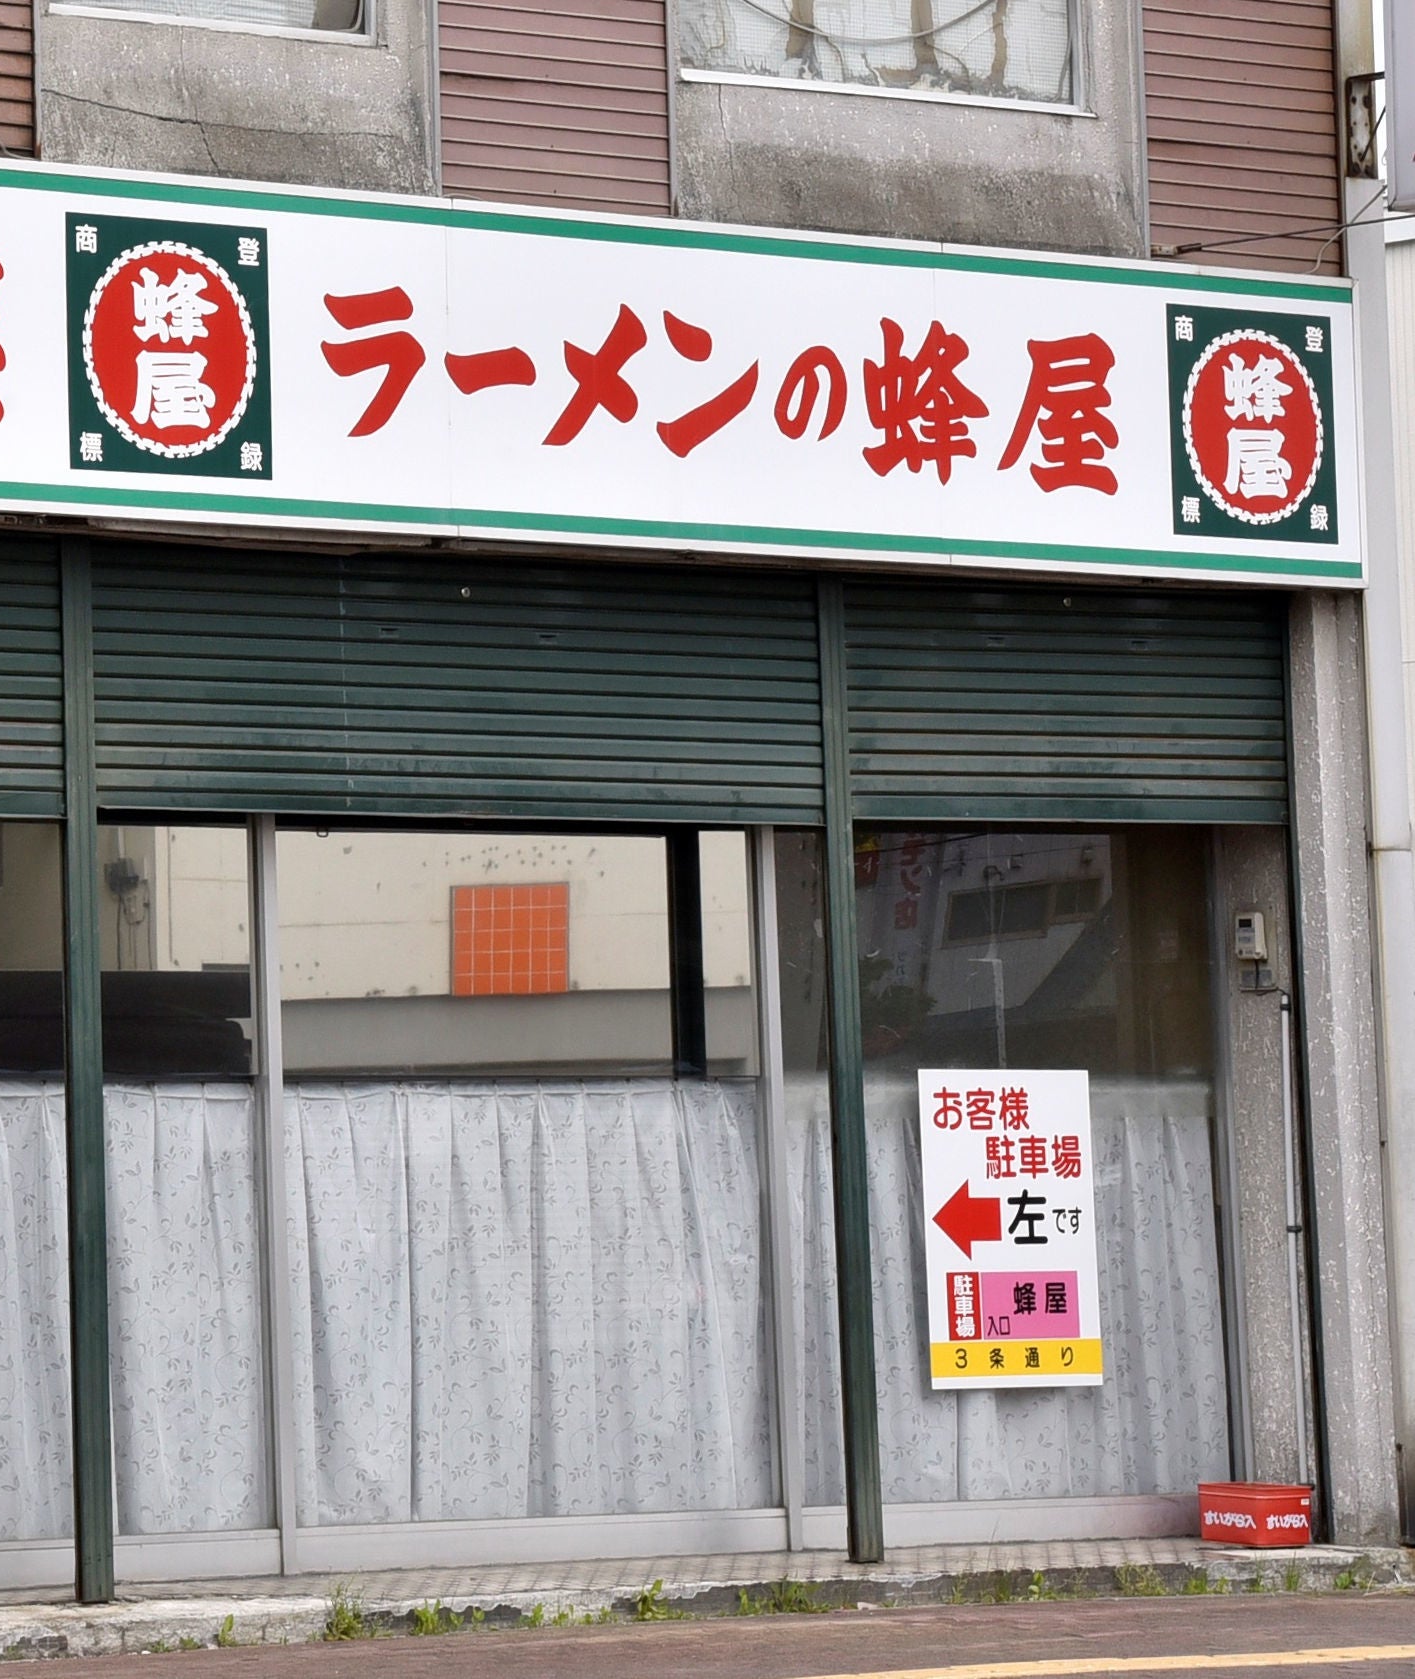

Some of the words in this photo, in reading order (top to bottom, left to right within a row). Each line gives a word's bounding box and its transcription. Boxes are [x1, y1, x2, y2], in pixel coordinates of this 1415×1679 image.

[74, 223, 99, 255] 商
[237, 236, 261, 268] 登
[1173, 314, 1195, 342] 商
[1304, 325, 1325, 354] 登
[130, 266, 219, 430] 蜂屋
[321, 286, 1119, 495] ラーメンの蜂屋
[1222, 352, 1293, 500] 蜂屋
[78, 431, 104, 463] 標
[240, 441, 263, 473] 録
[1180, 495, 1202, 525] 標
[1309, 503, 1329, 532] 録
[933, 1087, 1030, 1131] お客様
[986, 1135, 1081, 1180] 駐車場
[952, 1274, 976, 1338] 駐車場
[1013, 1281, 1068, 1315] 蜂屋
[987, 1316, 1011, 1336] 入口
